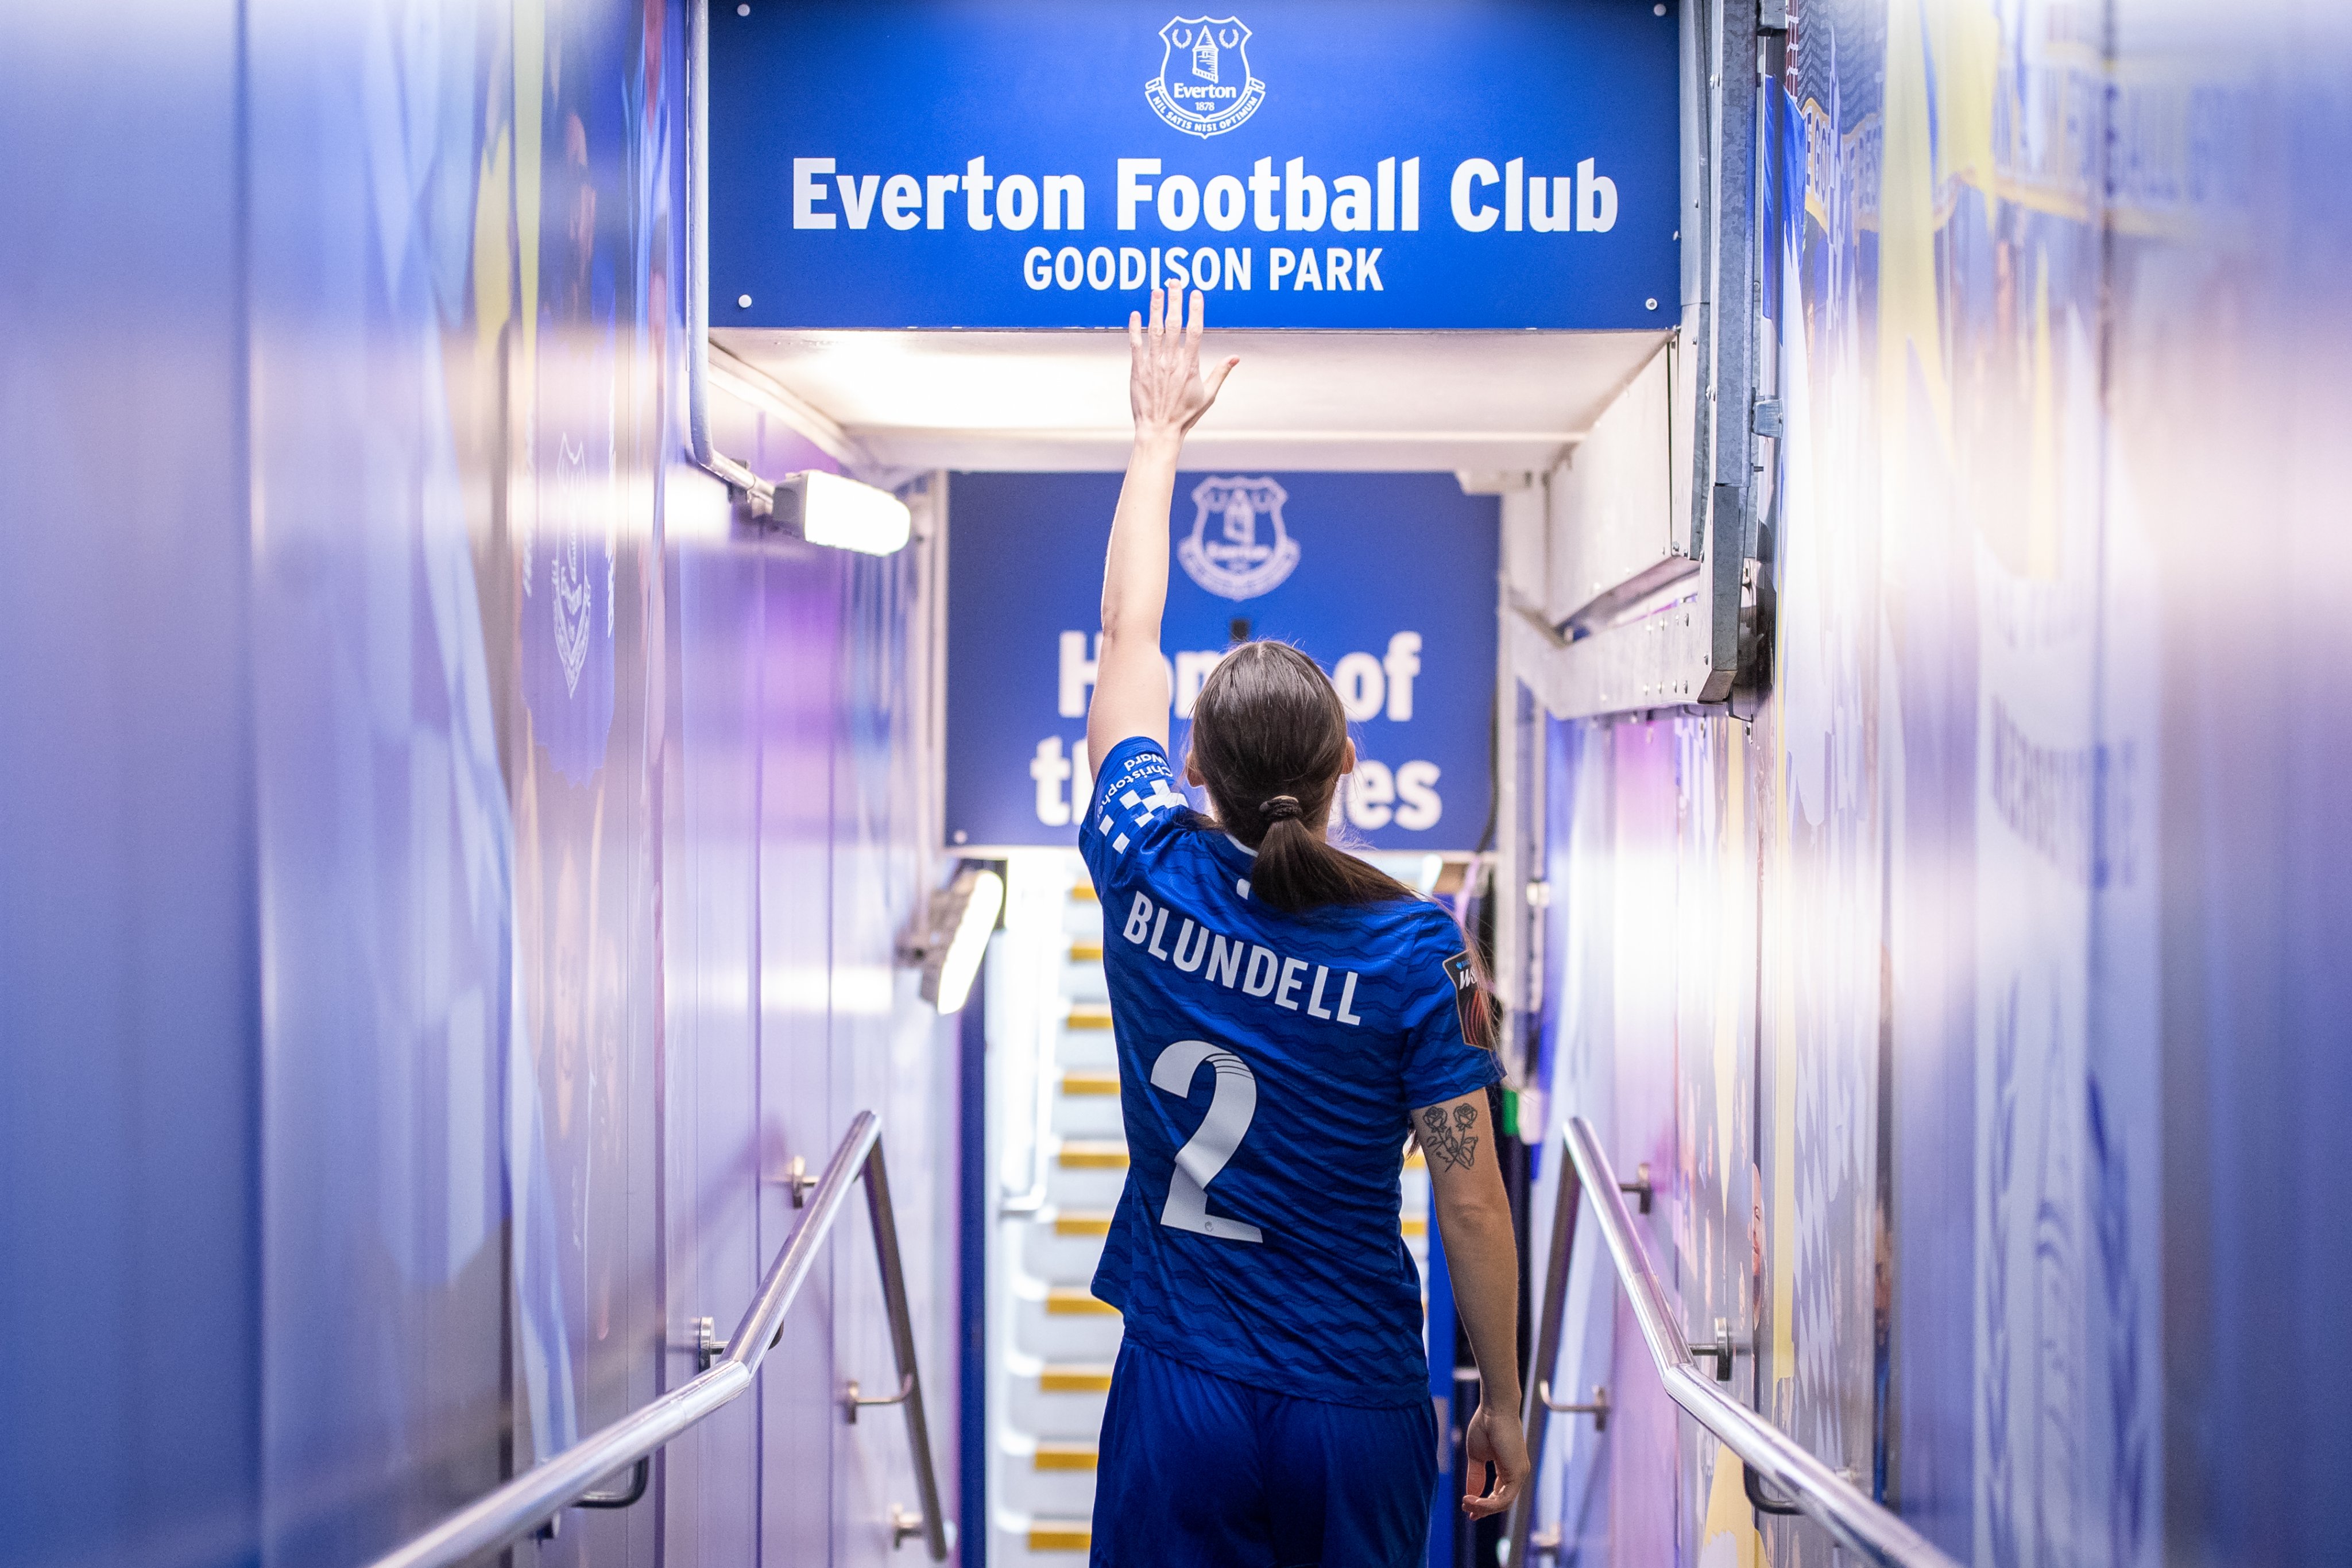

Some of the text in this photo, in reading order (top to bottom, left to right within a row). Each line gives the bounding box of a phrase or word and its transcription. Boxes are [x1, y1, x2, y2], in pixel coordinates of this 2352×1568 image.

[1152, 96, 1258, 132] NIL SATIS NISI OPTIMUM
[1174, 83, 1237, 99] Everton
[1195, 102, 1215, 111] 1878
[793, 155, 1618, 233] Everton Football Club
[1023, 246, 1384, 291] GOODISON PARK
[1333, 632, 1422, 722] of
[1123, 891, 1361, 1025] BLUNDELL
[1150, 1040, 1263, 1244] 2
